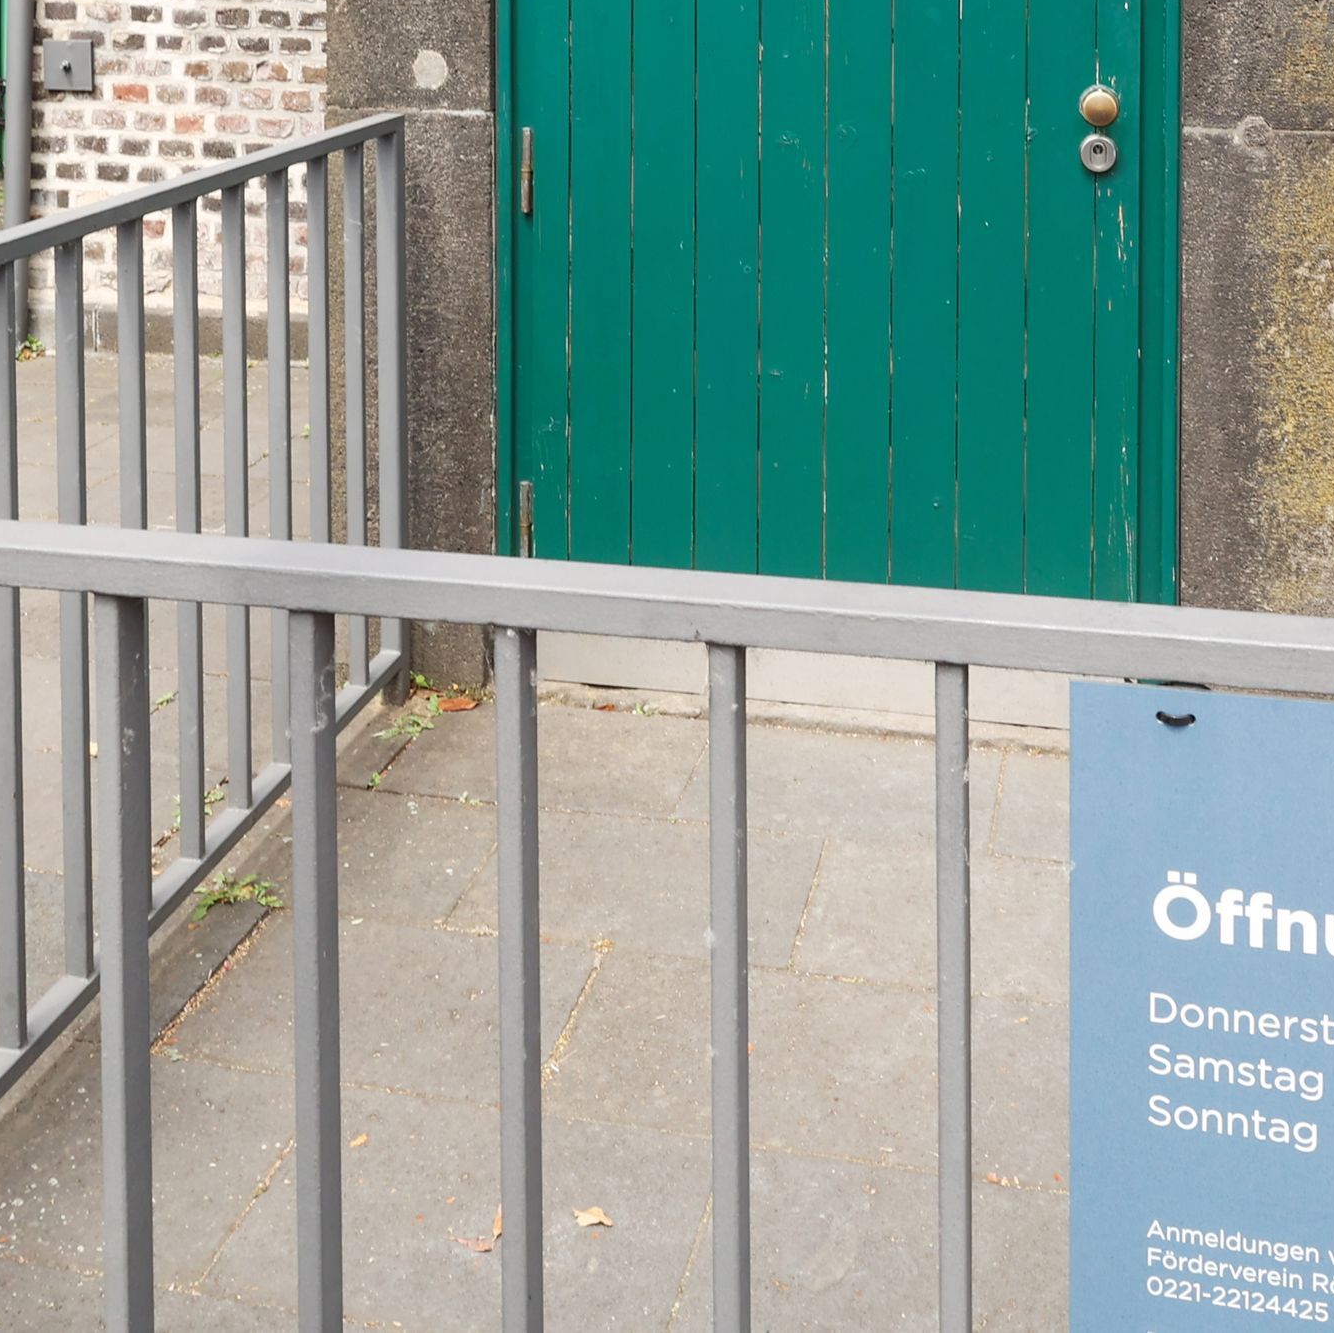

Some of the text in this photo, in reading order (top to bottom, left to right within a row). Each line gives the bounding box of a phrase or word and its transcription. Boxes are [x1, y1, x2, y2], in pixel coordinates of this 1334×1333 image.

[1148, 1043, 1324, 1101] Samstag
[1148, 1094, 1318, 1153] Sonntag
[1146, 1219, 1320, 1264] Anmeldungen
[1147, 1245, 1303, 1290] Förderverein
[1146, 1275, 1329, 1323] 0221-22124425
